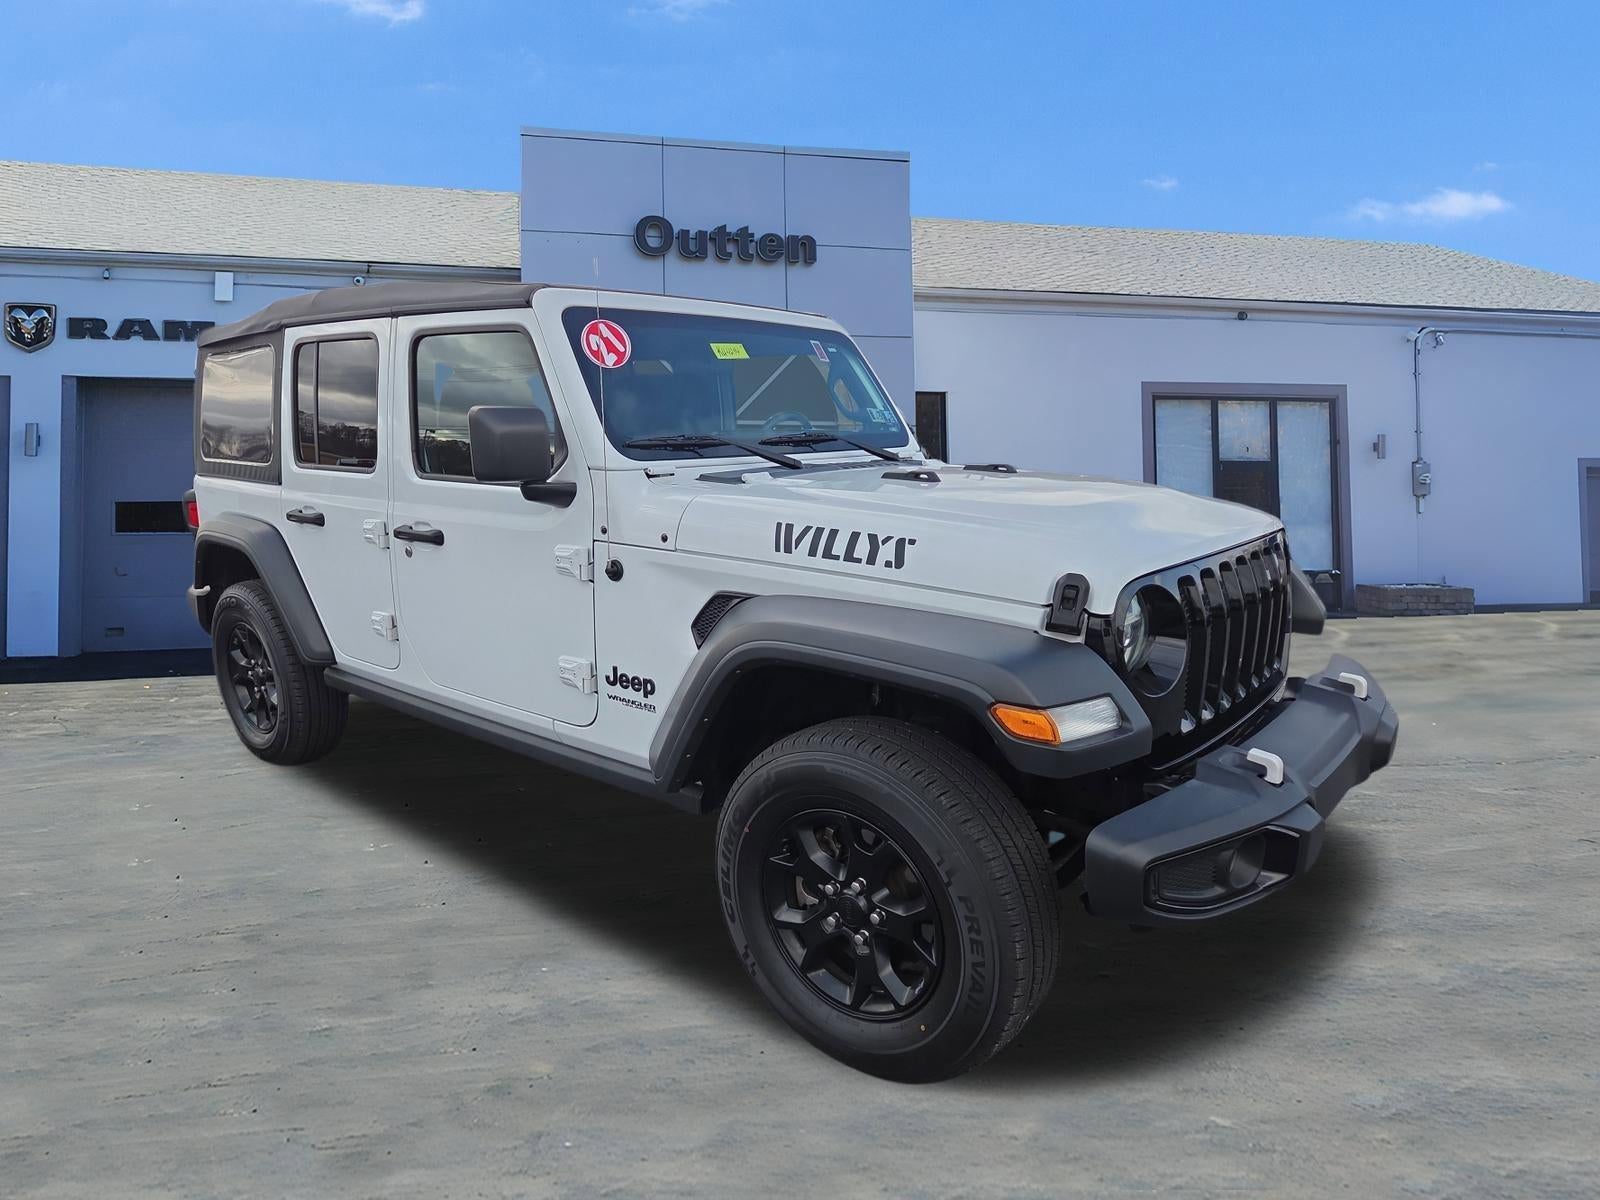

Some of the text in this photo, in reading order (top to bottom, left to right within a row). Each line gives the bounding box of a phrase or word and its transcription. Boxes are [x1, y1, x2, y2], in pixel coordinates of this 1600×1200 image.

[634, 215, 817, 264] Outten
[66, 317, 215, 342] RAM
[588, 323, 626, 367] 21
[774, 521, 917, 570] WILLYS
[604, 665, 656, 699] Jeep
[606, 692, 656, 712] WRANGLER
